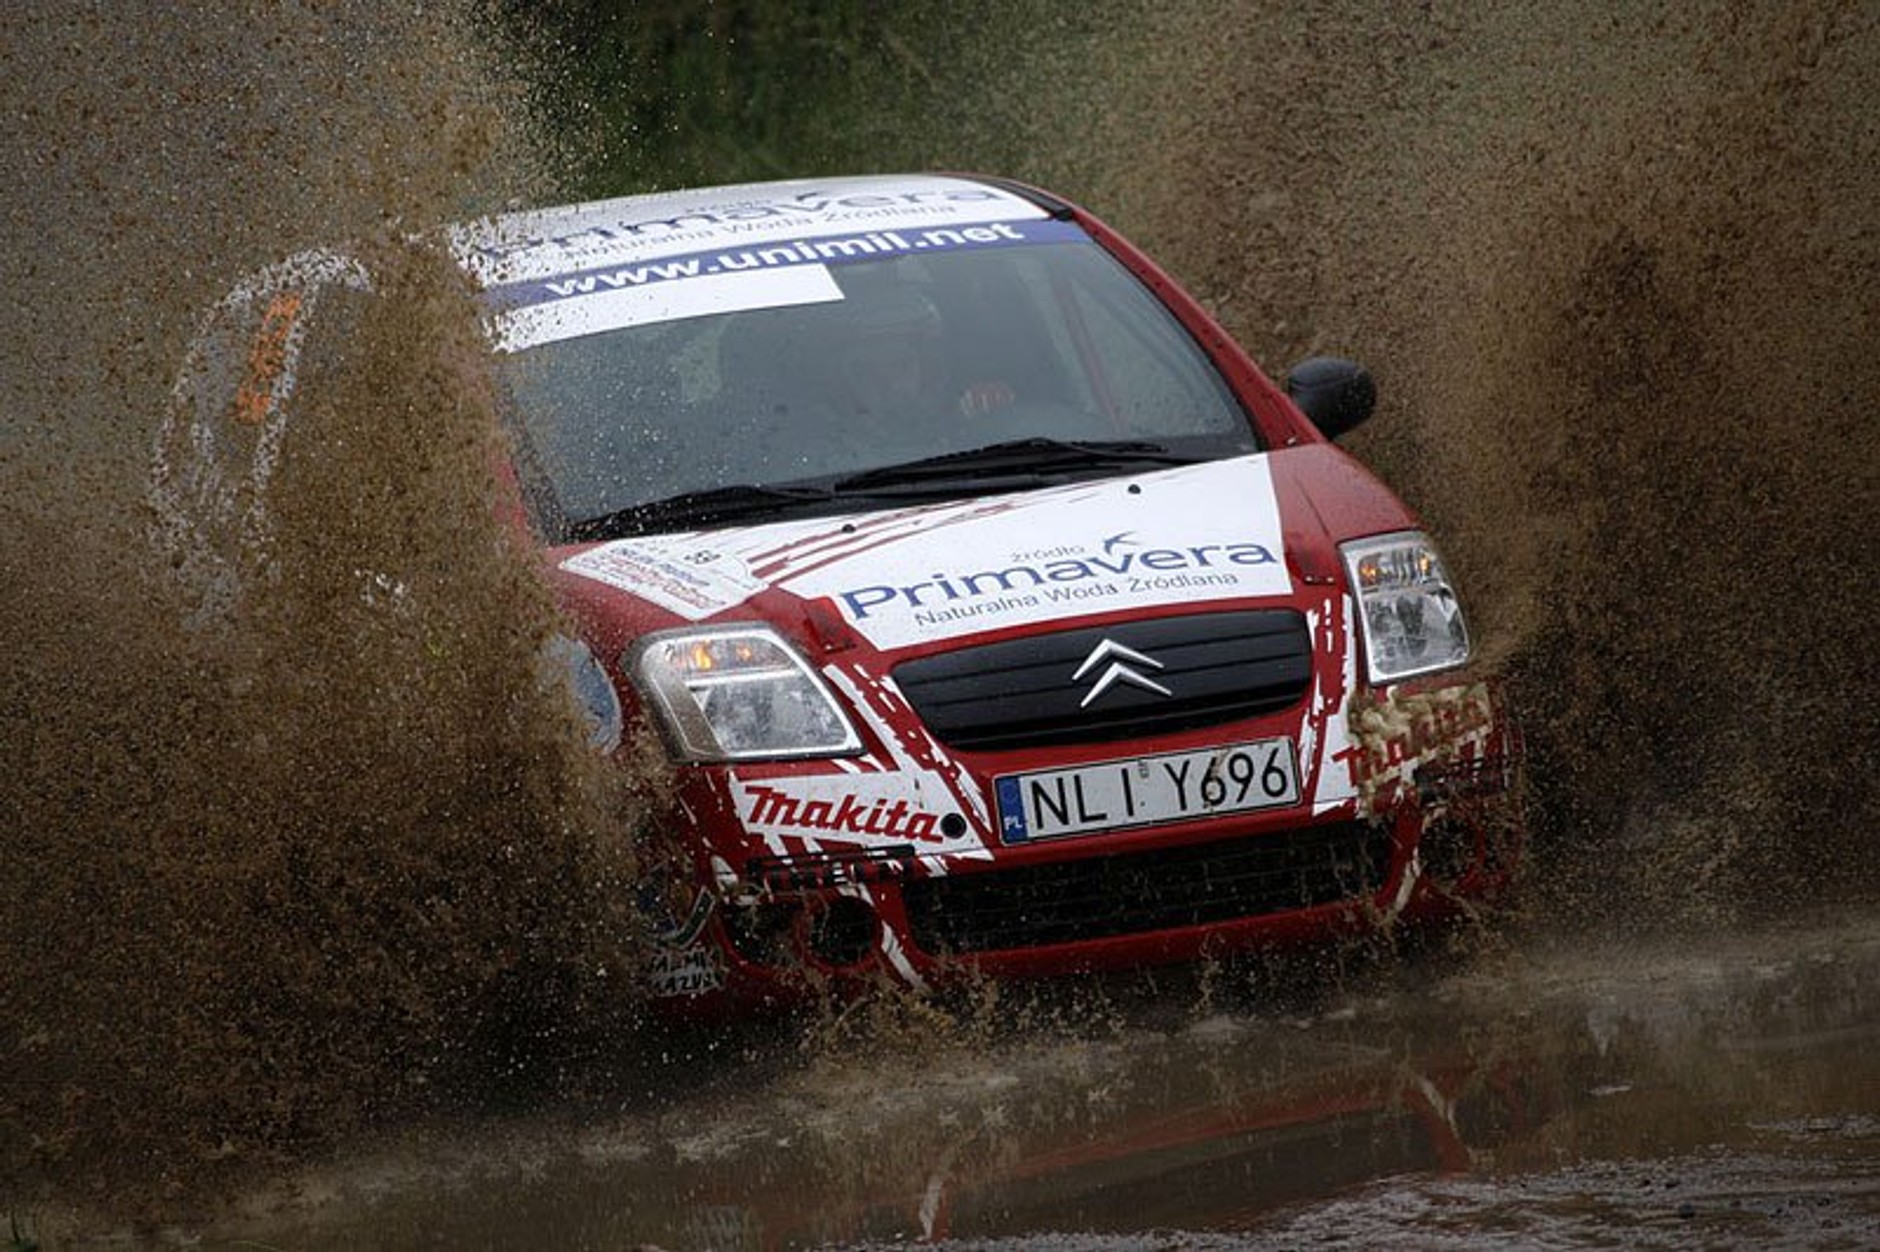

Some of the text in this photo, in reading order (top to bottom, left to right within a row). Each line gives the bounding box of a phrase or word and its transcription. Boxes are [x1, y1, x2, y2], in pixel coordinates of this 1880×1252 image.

[545, 222, 1025, 297] www.unimil.net
[839, 540, 1278, 621] Primavera
[914, 592, 1040, 627] Naturalna
[1044, 580, 1119, 606] Woda
[1162, 747, 1289, 812] Y696
[1003, 815, 1024, 831] PL
